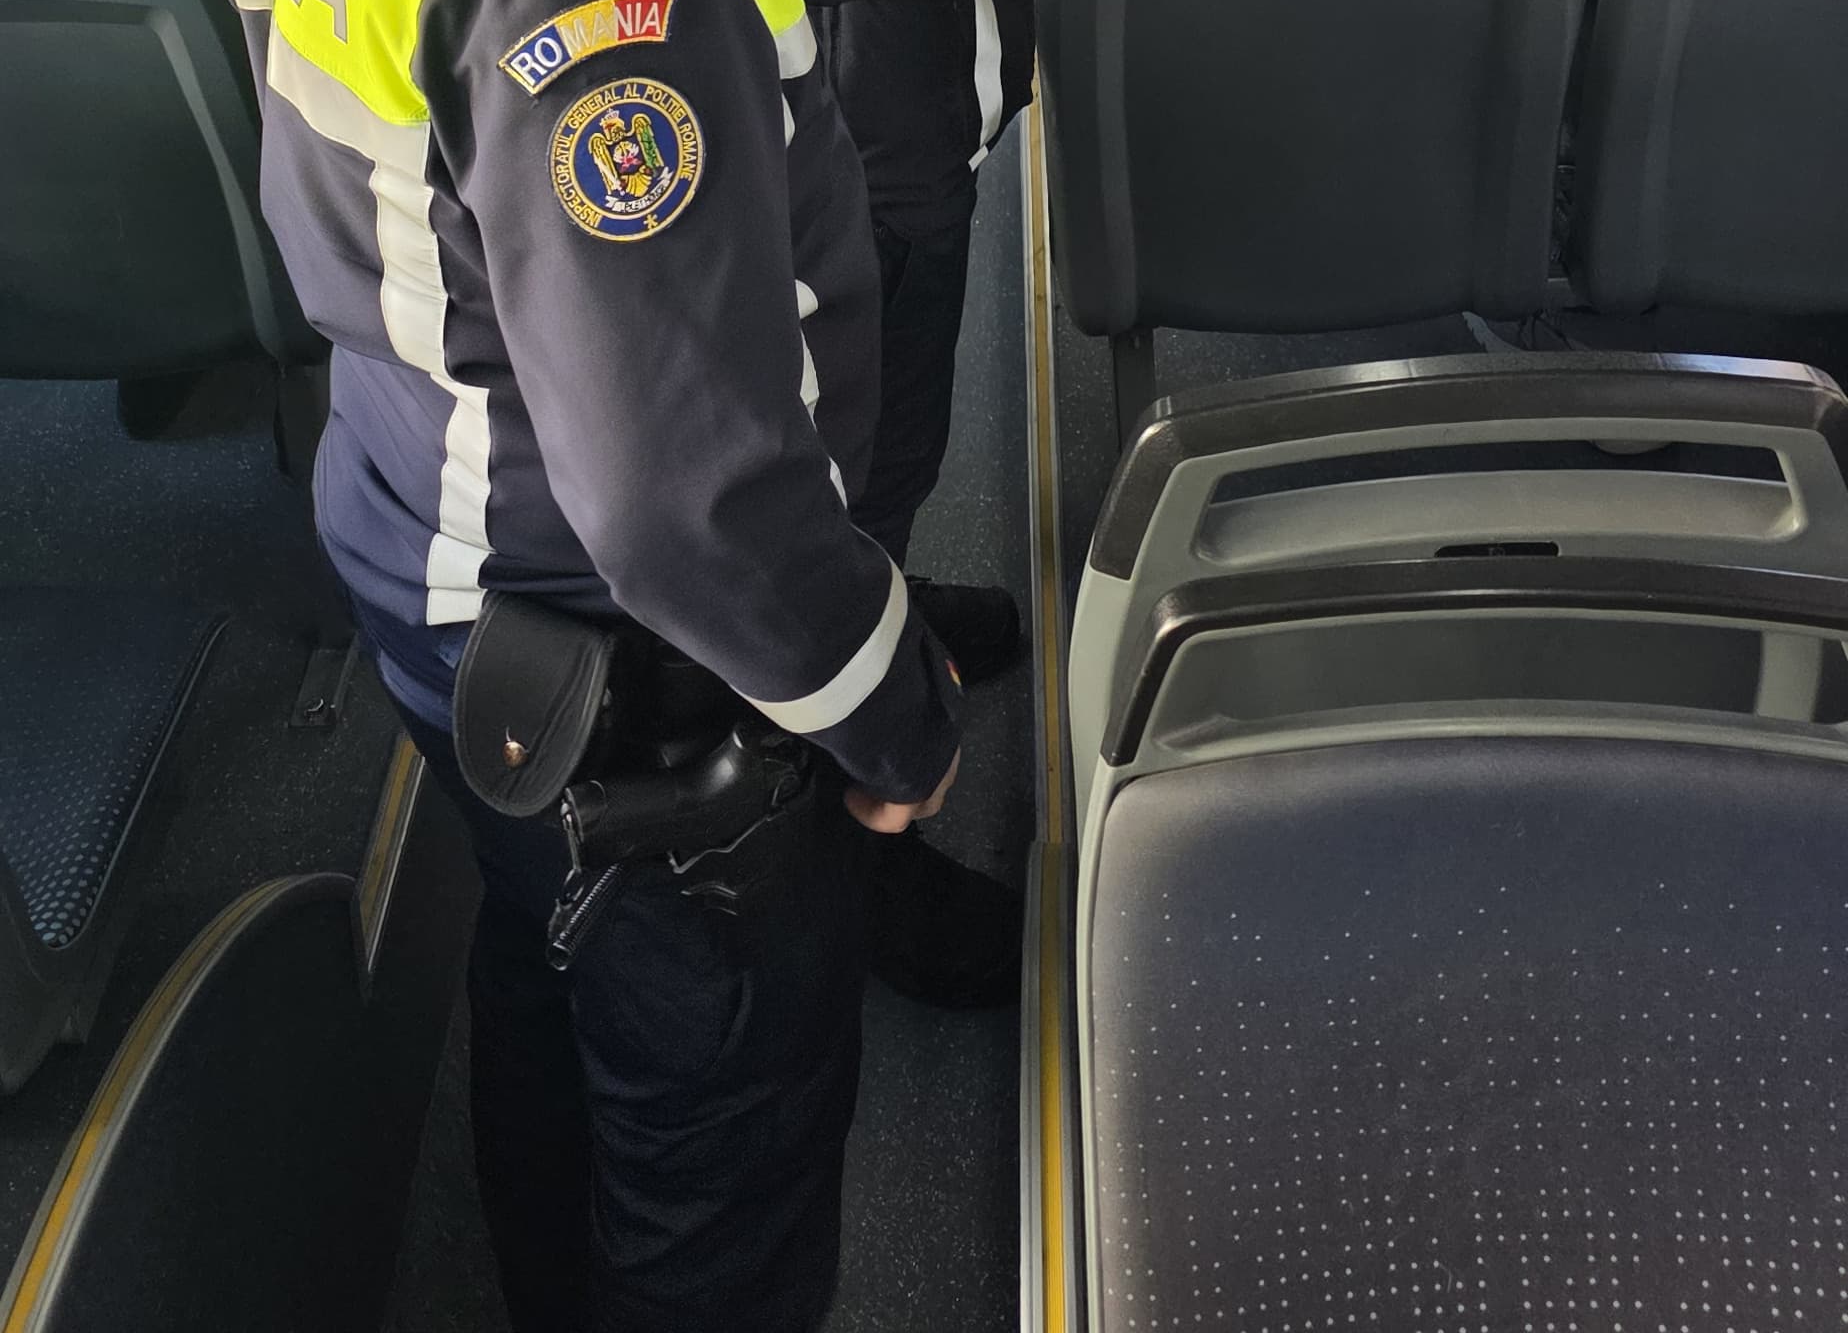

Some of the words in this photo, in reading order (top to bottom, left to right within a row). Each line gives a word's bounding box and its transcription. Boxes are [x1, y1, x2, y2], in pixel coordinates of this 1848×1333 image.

[510, 2, 662, 86] ROMANIA
[567, 88, 621, 129] GENERAL
[623, 83, 641, 99] AL
[643, 85, 685, 121] POLITIE
[679, 122, 698, 181] ROMANE
[556, 133, 603, 228] INSPECTORATUL
